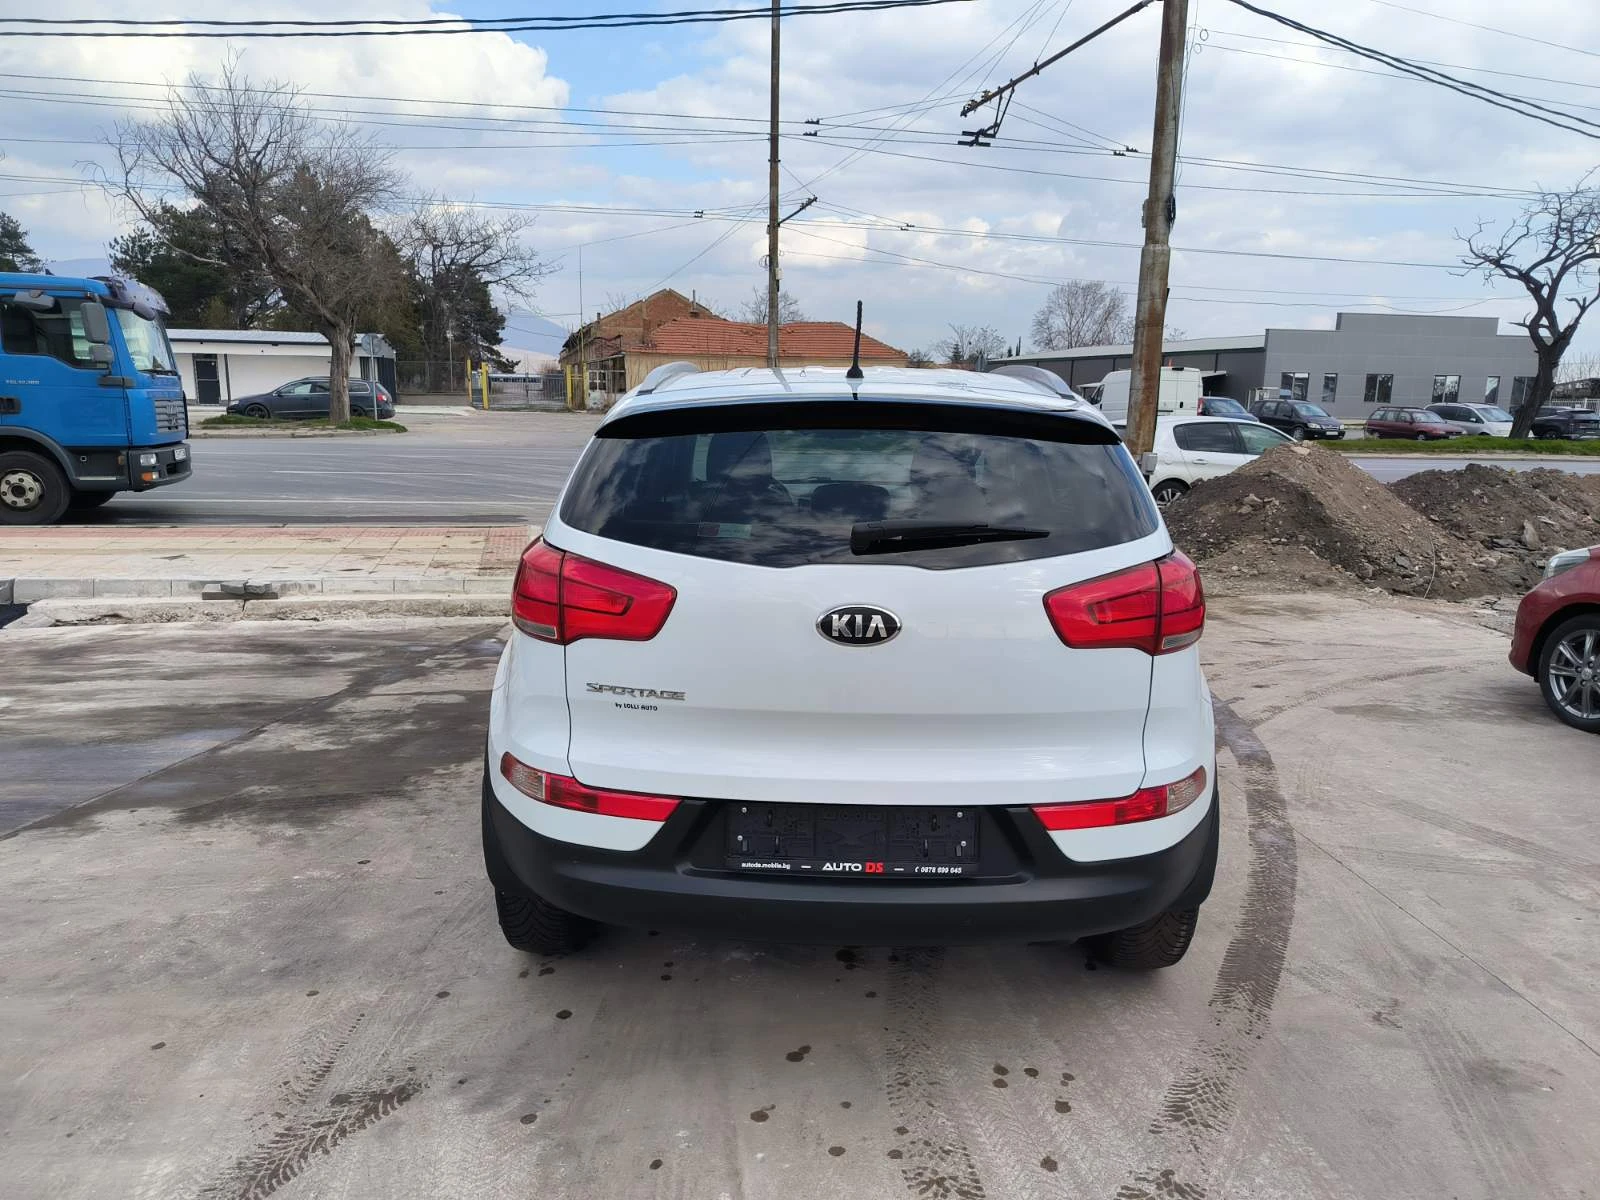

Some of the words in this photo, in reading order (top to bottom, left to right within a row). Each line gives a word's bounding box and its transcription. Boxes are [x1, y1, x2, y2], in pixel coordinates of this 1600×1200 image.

[831, 614, 888, 638] KIA
[585, 682, 686, 701] SPORTAGE
[822, 862, 862, 872] AUTO
[865, 862, 884, 873] DS
